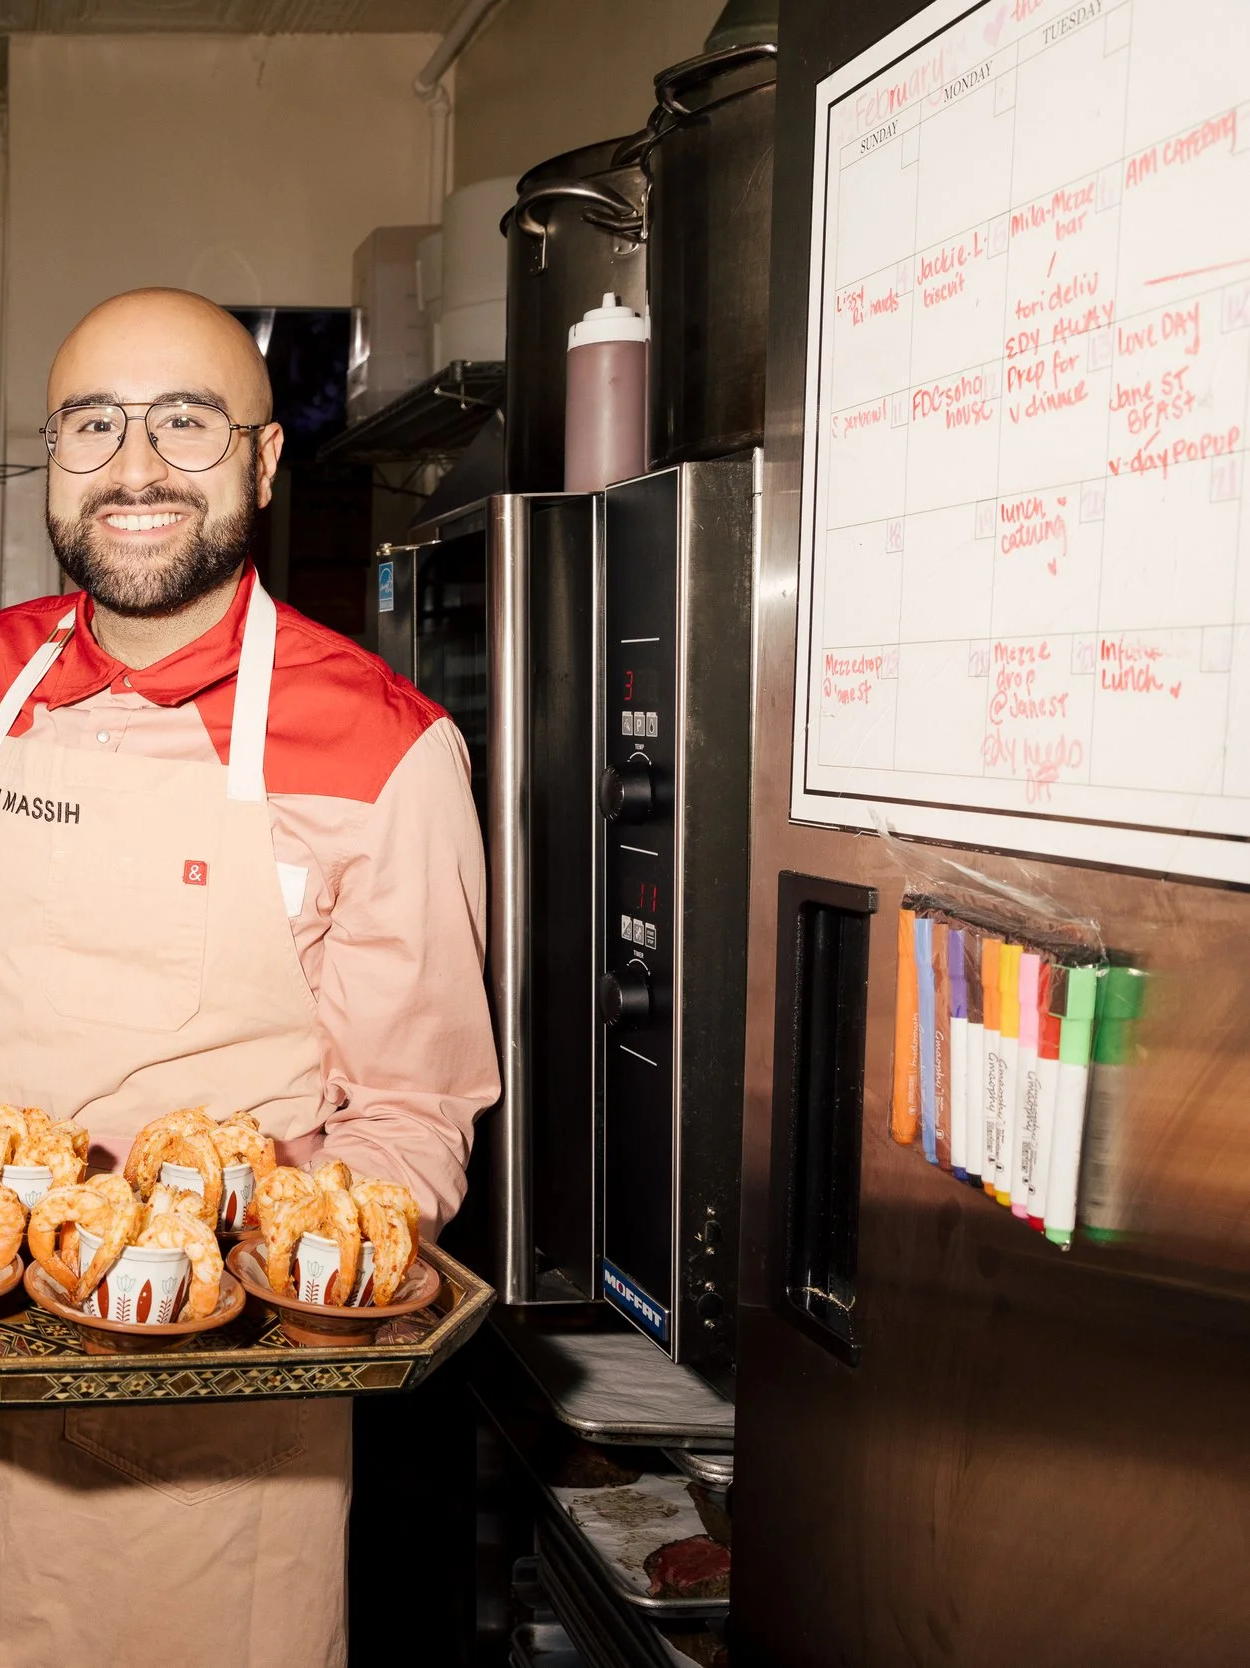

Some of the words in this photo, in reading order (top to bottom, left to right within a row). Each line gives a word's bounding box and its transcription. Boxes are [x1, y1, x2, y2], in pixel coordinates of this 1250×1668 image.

[1042, 0, 1103, 45] TUESDAY
[855, 48, 946, 133] February
[943, 60, 993, 103] MONDAY
[860, 120, 899, 154] SUNDAY
[1056, 210, 1087, 240] bar
[923, 272, 965, 308] biscuit
[1161, 302, 1200, 356] DAY
[1053, 350, 1080, 389] for
[624, 670, 634, 700] 3
[996, 664, 1036, 696] drop
[2, 790, 80, 825] MASSIH
[188, 864, 202, 882] &
[604, 1269, 662, 1328] MOFFAT
